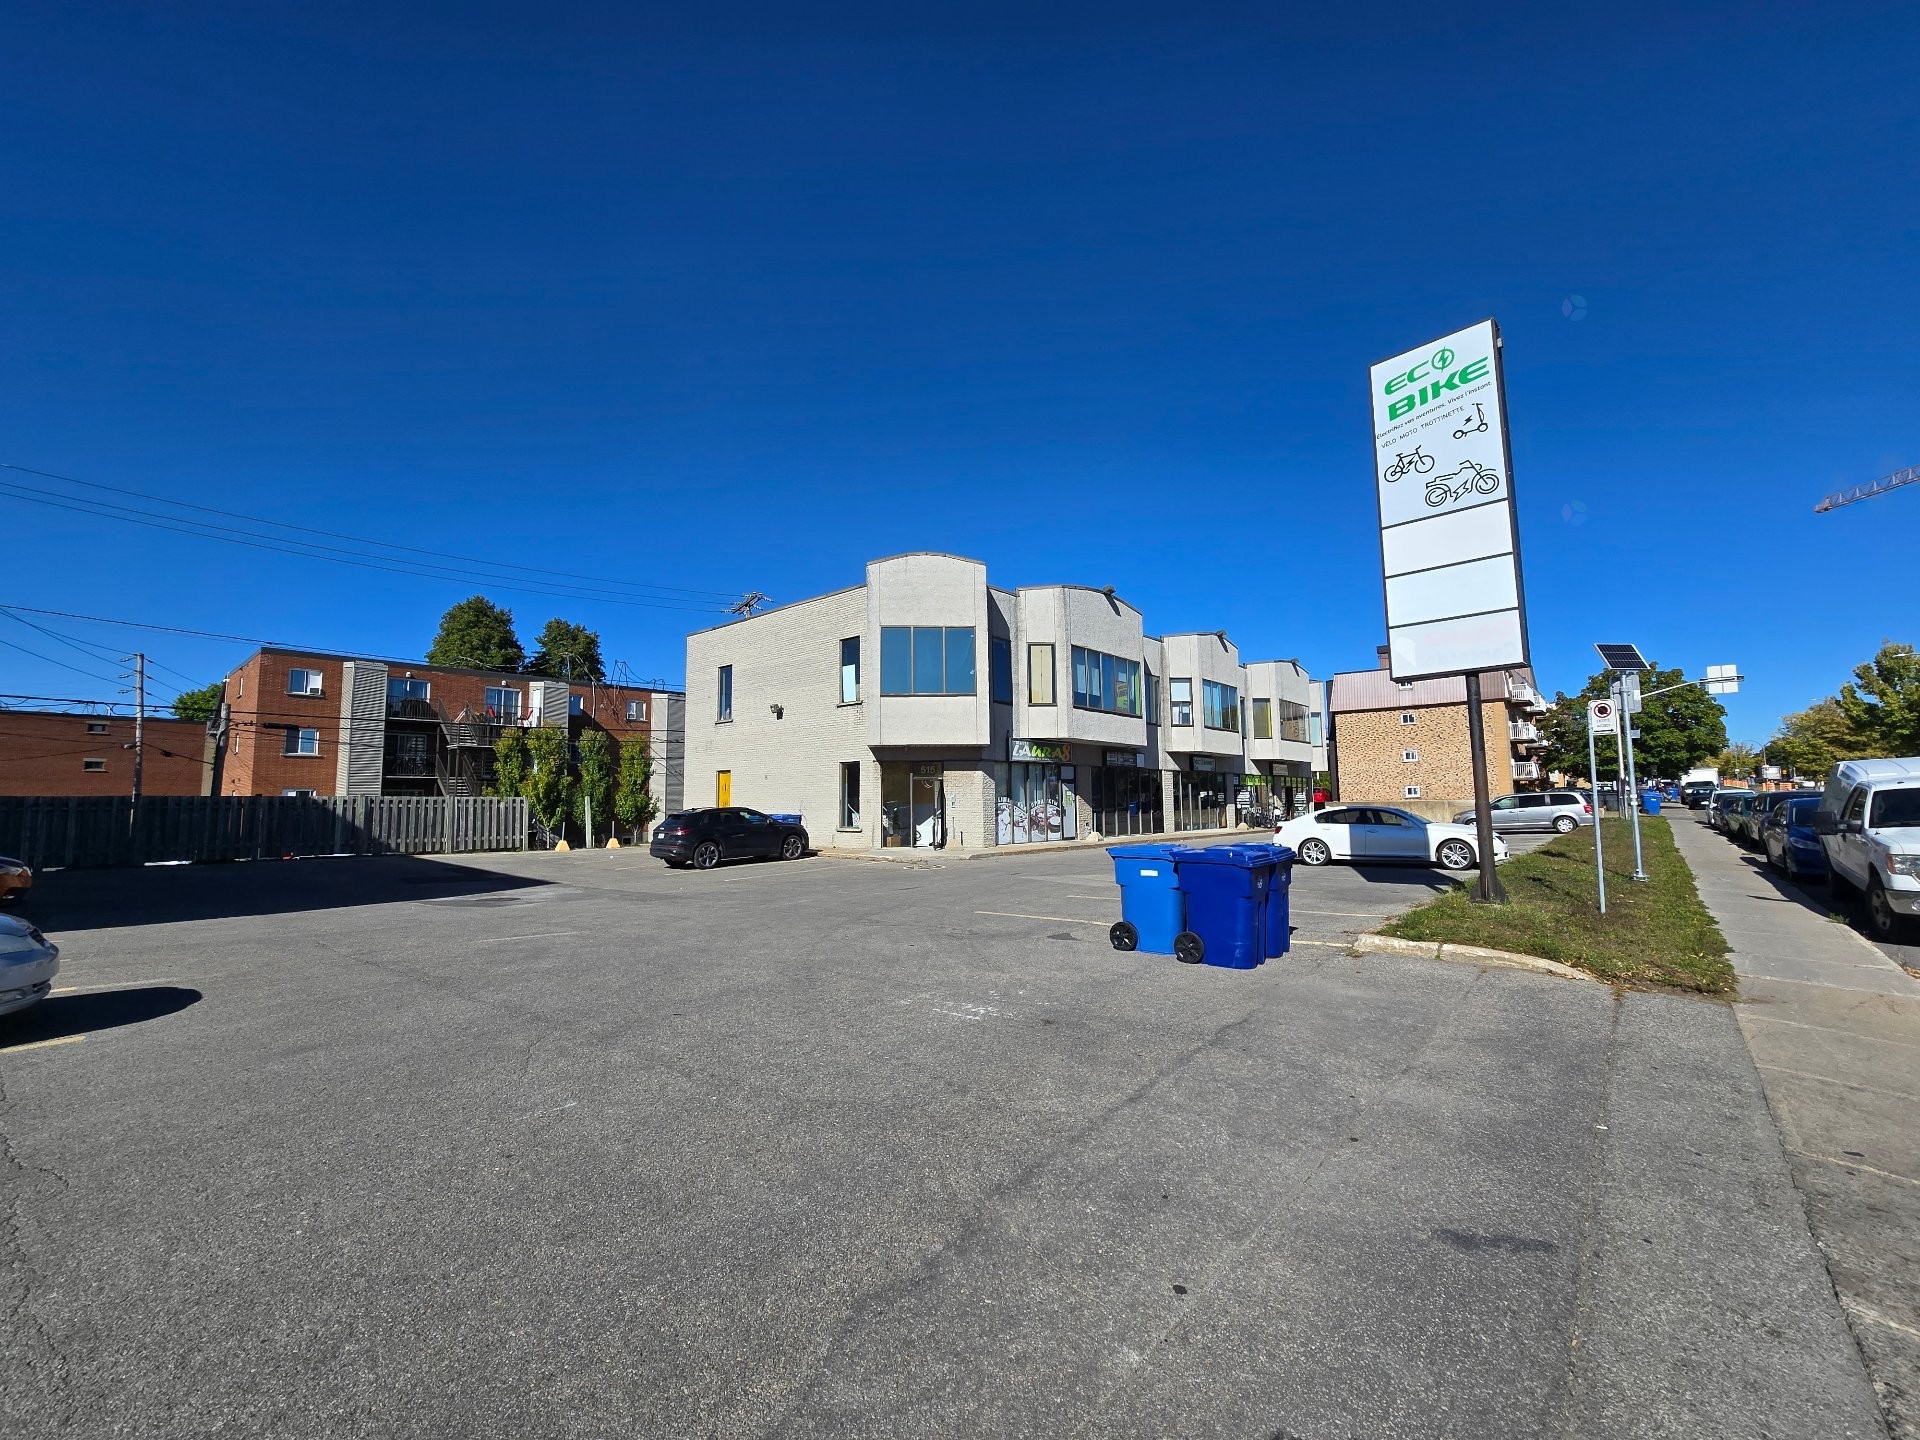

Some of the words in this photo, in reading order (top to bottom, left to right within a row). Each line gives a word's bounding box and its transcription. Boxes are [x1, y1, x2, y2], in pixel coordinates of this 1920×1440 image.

[1387, 356, 1490, 422] BIKE
[1399, 428, 1418, 440] MOTO
[1420, 405, 1465, 430] TROTTINETTE
